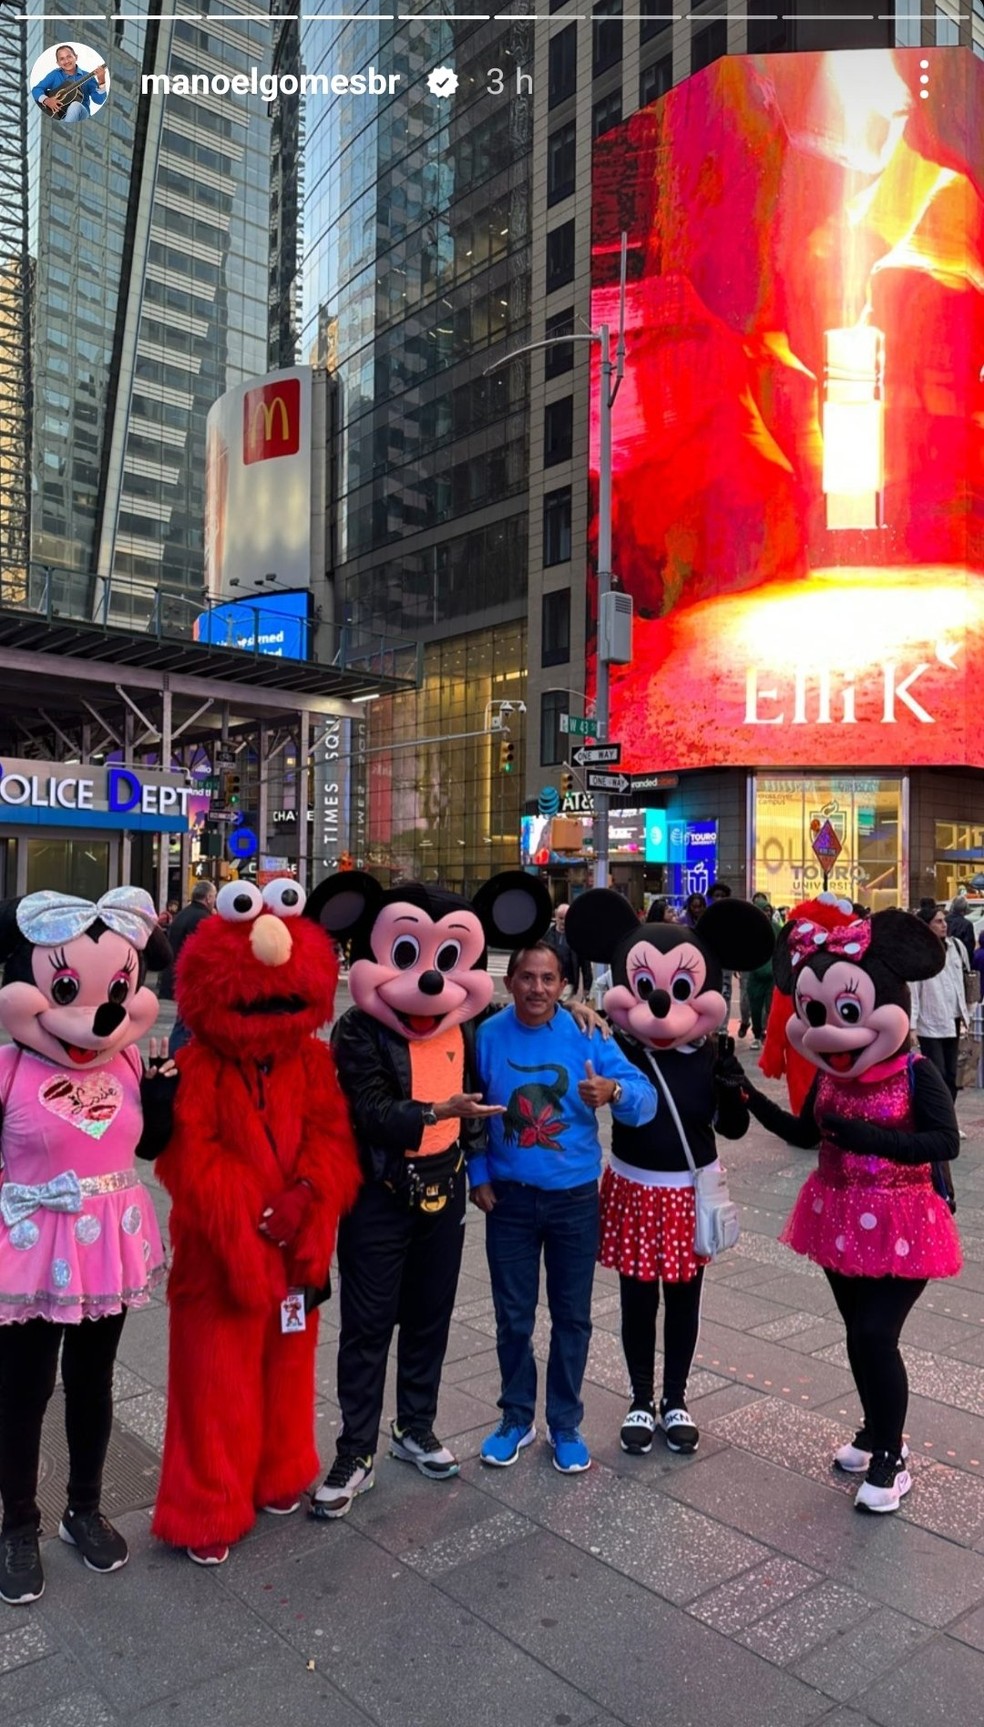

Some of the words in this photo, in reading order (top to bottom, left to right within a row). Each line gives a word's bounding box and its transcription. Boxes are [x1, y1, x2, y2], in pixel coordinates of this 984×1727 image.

[743, 663, 858, 724] Elli
[880, 663, 937, 724] K
[580, 720, 588, 735] 43
[578, 751, 592, 761] ONE
[598, 749, 614, 760] WAY
[0, 762, 94, 809] OLICE
[593, 777, 607, 786] ONE
[612, 779, 625, 788] WAY
[631, 777, 658, 789] randed
[562, 791, 595, 811] AT&
[272, 810, 315, 822] CHAE
[324, 783, 338, 844] TIMES
[690, 832, 717, 841] TOURO
